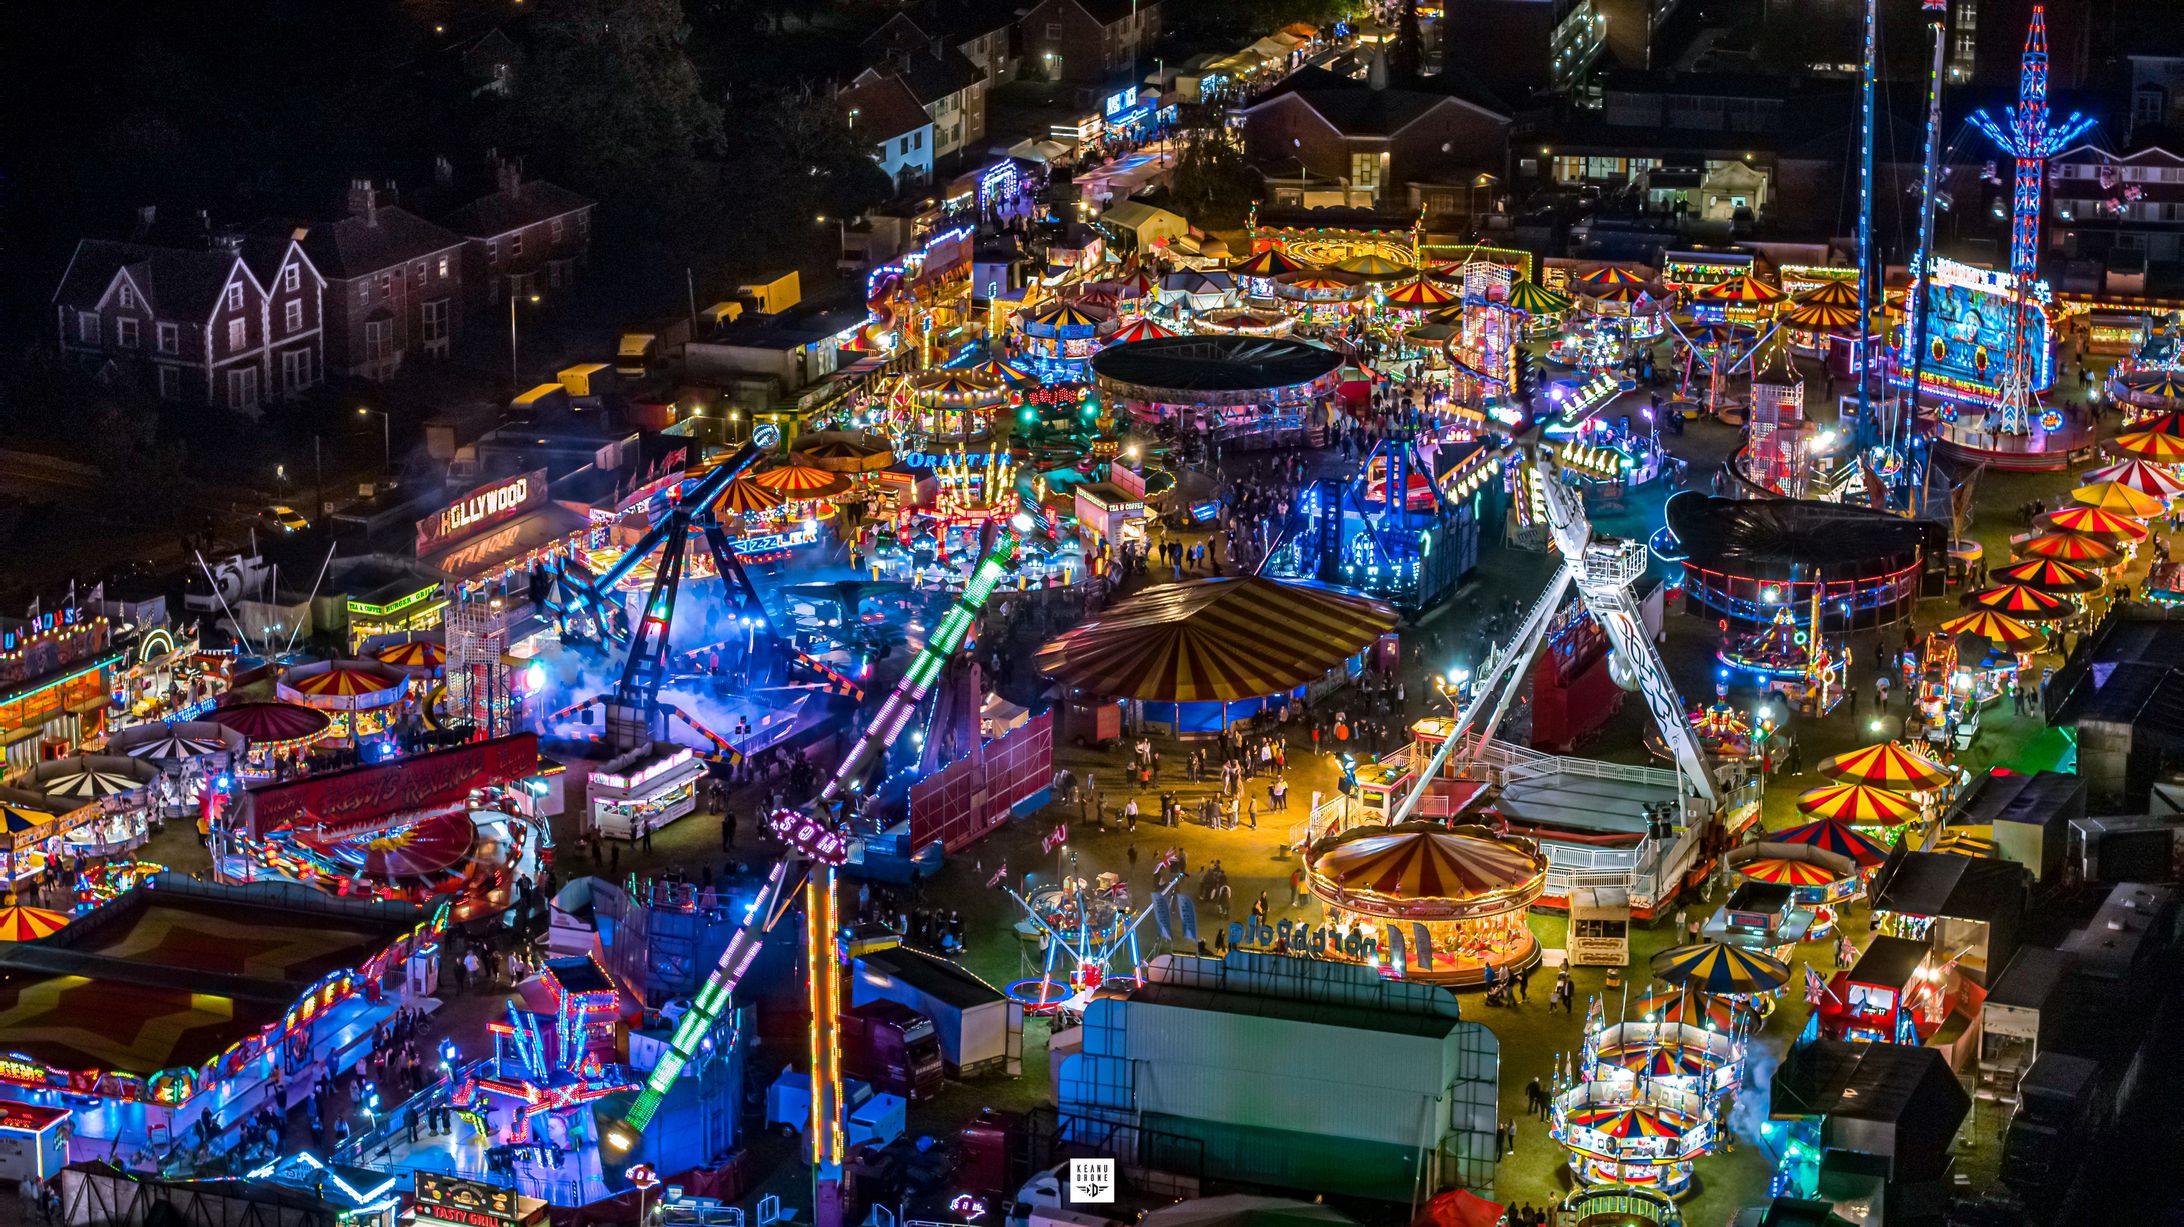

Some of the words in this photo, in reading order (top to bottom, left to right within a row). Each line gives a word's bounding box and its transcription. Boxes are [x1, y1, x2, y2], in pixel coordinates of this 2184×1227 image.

[906, 452, 1012, 468] ORBITER
[441, 478, 527, 536] HOLLYWOOD
[386, 597, 411, 612] BURGER
[31, 606, 84, 635] HOUSE
[432, 1205, 467, 1222] TASTY
[468, 1212, 500, 1227] GRILL
